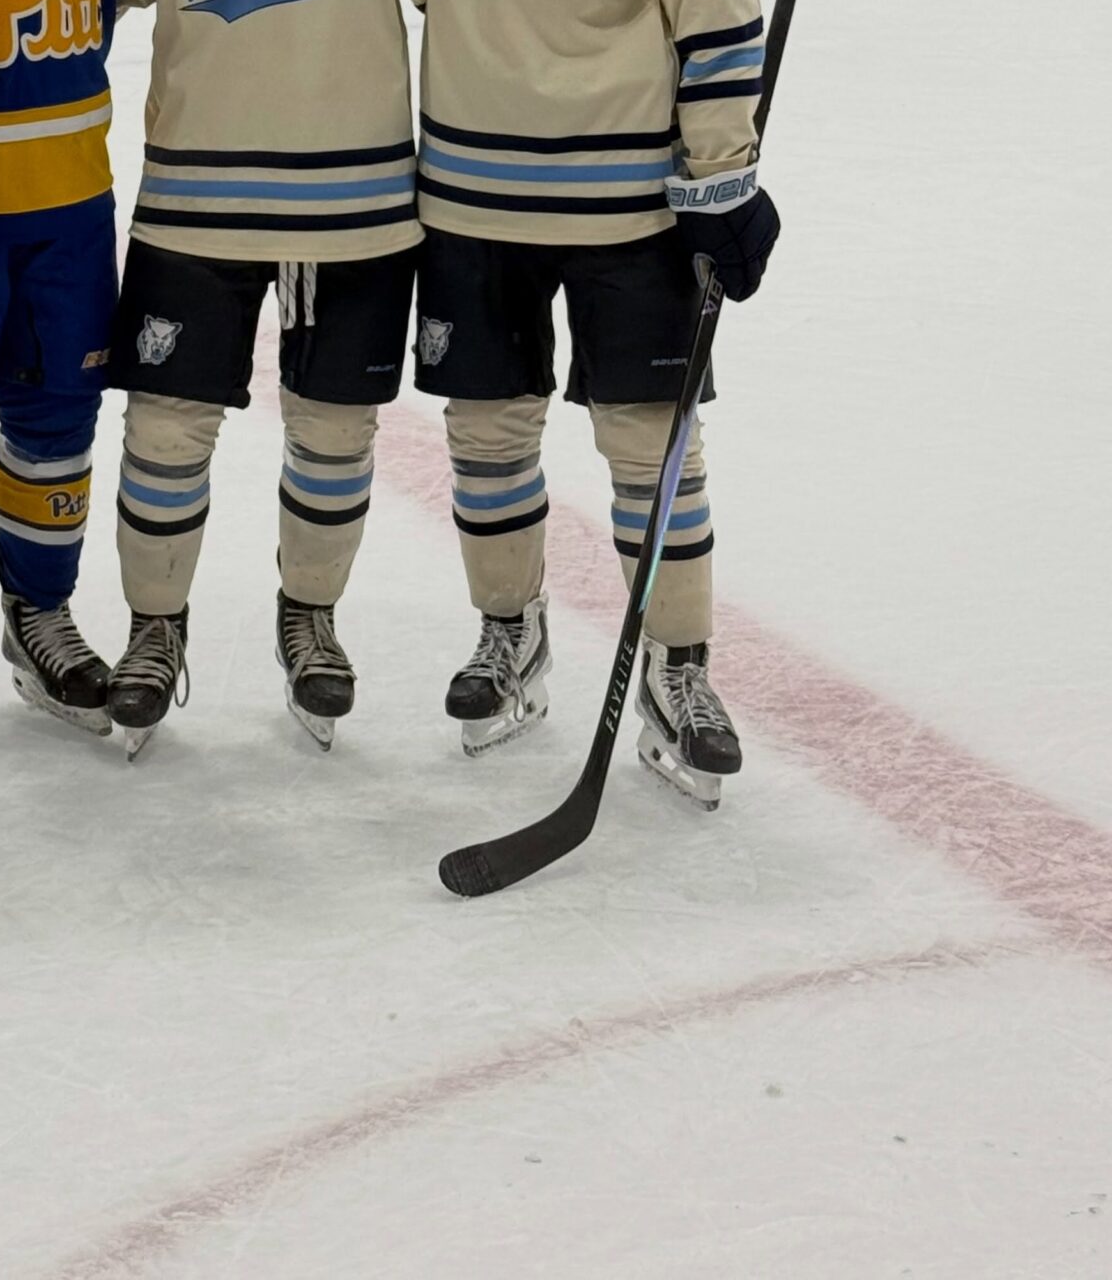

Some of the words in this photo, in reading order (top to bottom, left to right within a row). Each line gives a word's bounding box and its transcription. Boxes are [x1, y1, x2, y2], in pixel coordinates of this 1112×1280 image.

[666, 169, 757, 208] AUER
[44, 490, 88, 518] Pitt
[604, 640, 635, 734] FLYLITE
